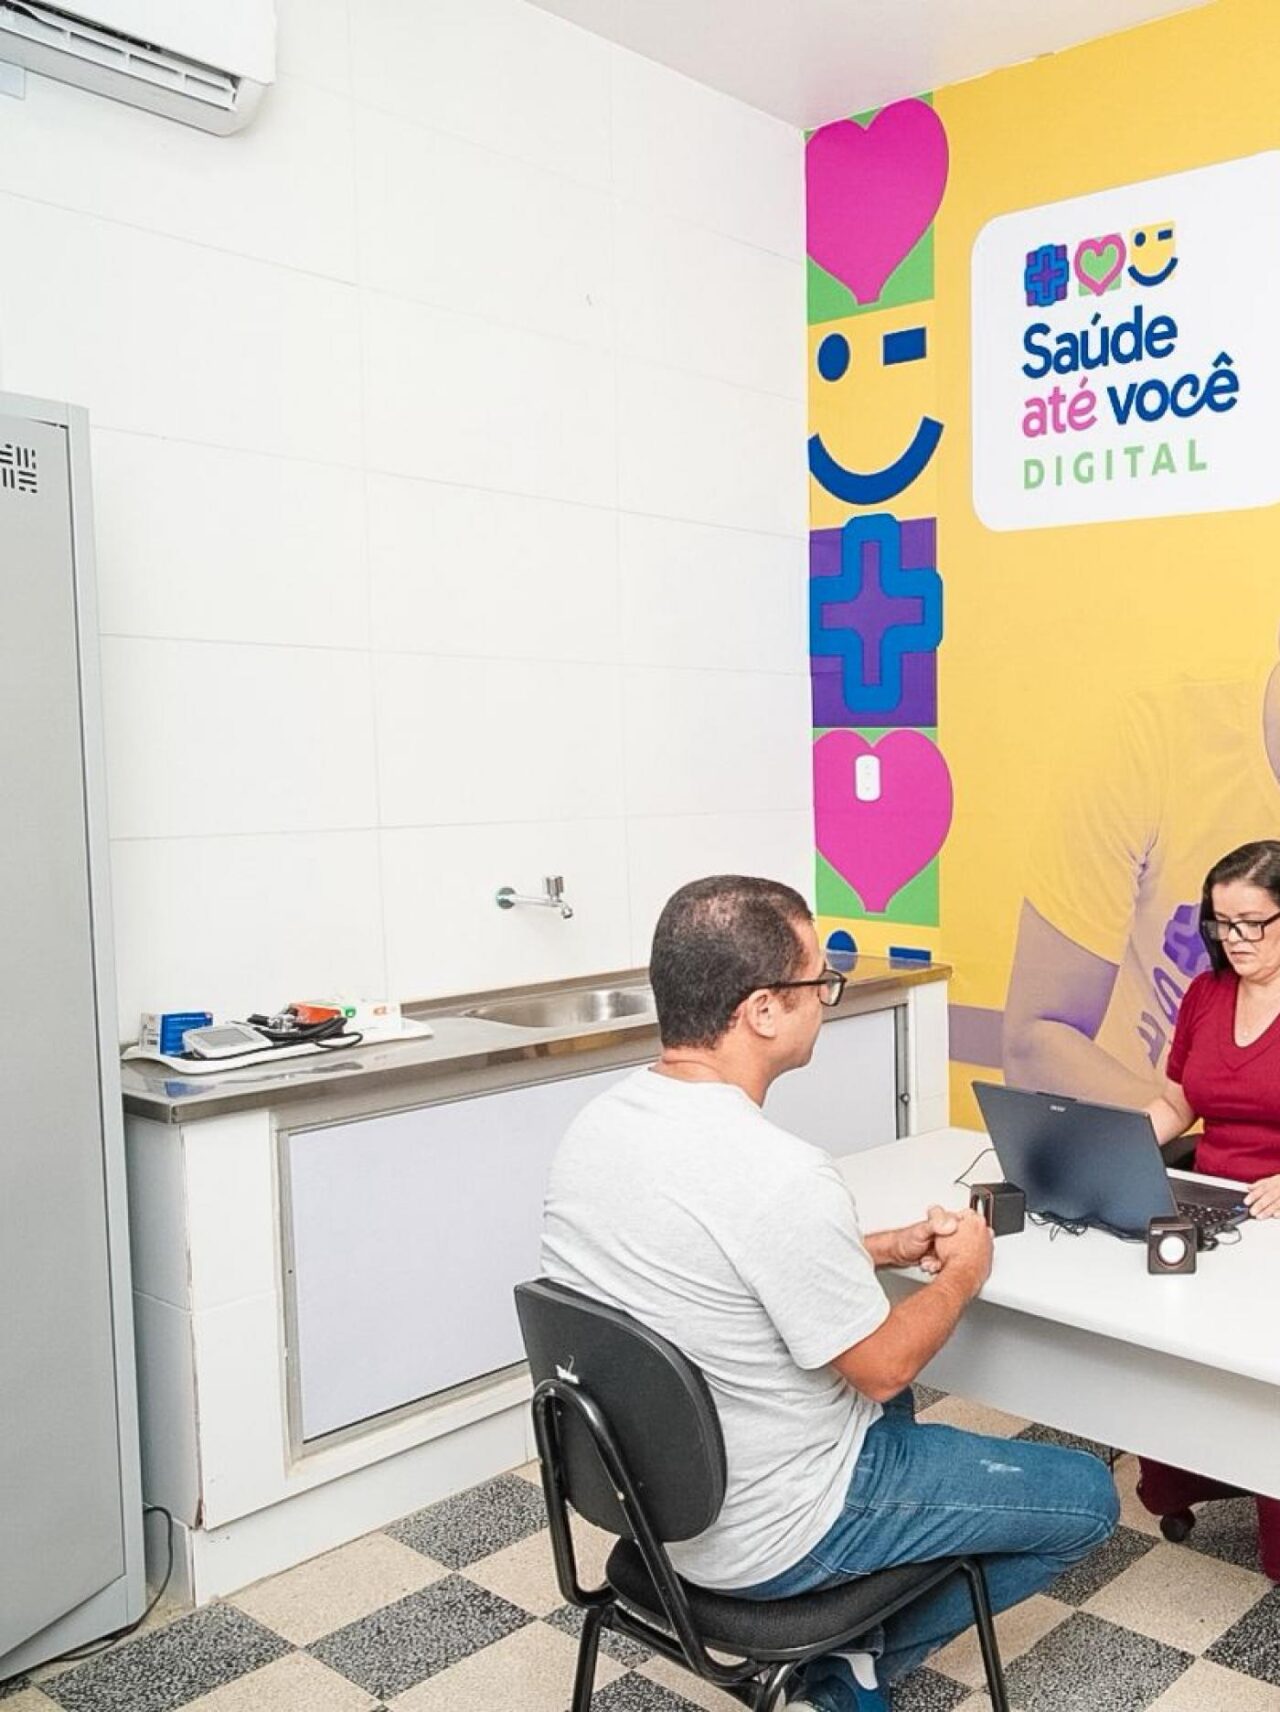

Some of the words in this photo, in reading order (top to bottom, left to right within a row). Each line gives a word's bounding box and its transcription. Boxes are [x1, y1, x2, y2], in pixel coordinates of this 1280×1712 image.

[1022, 304, 1178, 379] Saúde
[1022, 377, 1097, 438] até
[1107, 351, 1240, 425] você
[1023, 439, 1207, 489] DIGITAL
